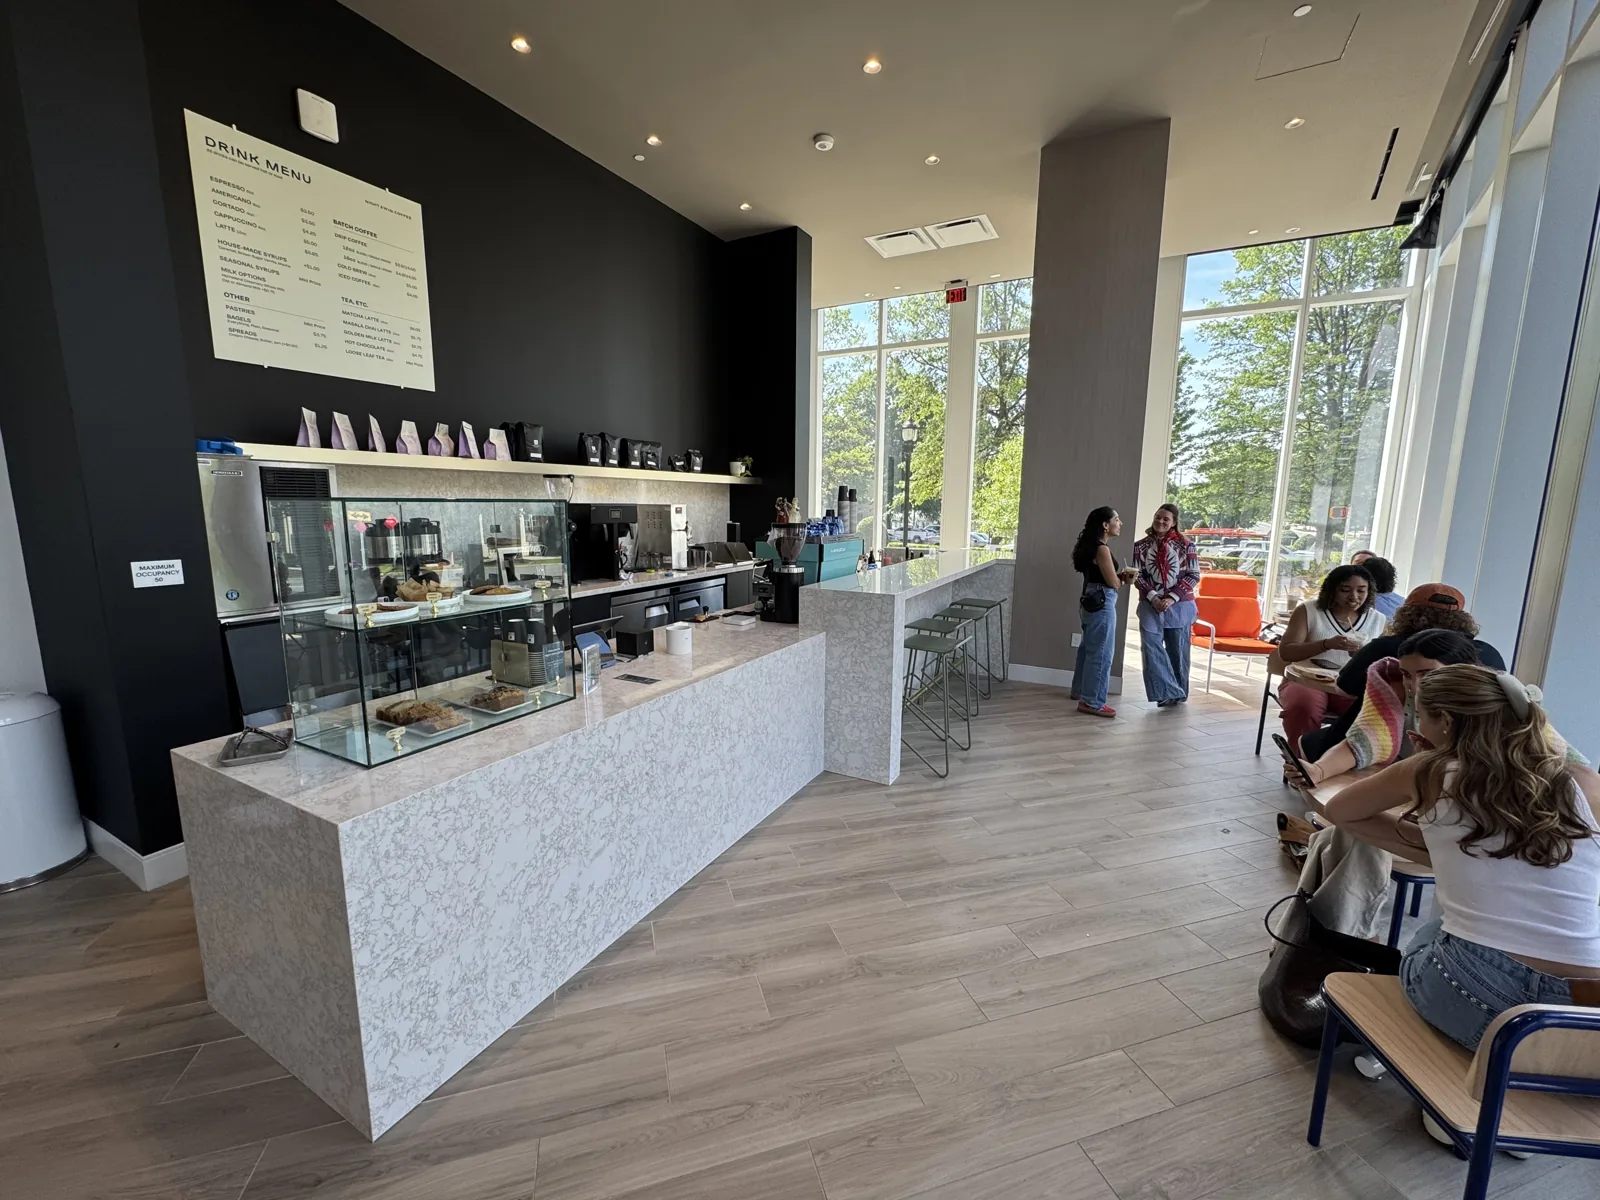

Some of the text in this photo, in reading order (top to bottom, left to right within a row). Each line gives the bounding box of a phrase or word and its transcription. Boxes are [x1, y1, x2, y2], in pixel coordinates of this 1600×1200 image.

[205, 136, 312, 185] DRINK MENU
[210, 176, 245, 192] ESPRESSO
[212, 188, 252, 205] AMERICANO
[213, 200, 245, 214] CORTADO
[215, 211, 257, 228] CAPPUCCINO
[216, 223, 235, 232] LATTE
[334, 219, 378, 239] BATCH COFFEE
[348, 238, 367, 247] COFFEE
[218, 239, 287, 263] HOUSE-MADE SYRUPS
[220, 256, 280, 276] SEASONAL SYRUPS
[221, 267, 266, 282] MILK OPTIONS
[352, 277, 371, 286] COFFEE
[224, 292, 250, 302] OTHER
[949, 288, 965, 303] EXIT
[226, 305, 256, 315] PASTRIES
[342, 311, 364, 319] MATCHA
[227, 314, 252, 323] BAGELS
[343, 320, 364, 328] MASALA
[229, 328, 257, 337] SPREADS
[356, 342, 385, 351] CHOCOLATE
[136, 570, 180, 578] OCCUPANCY
